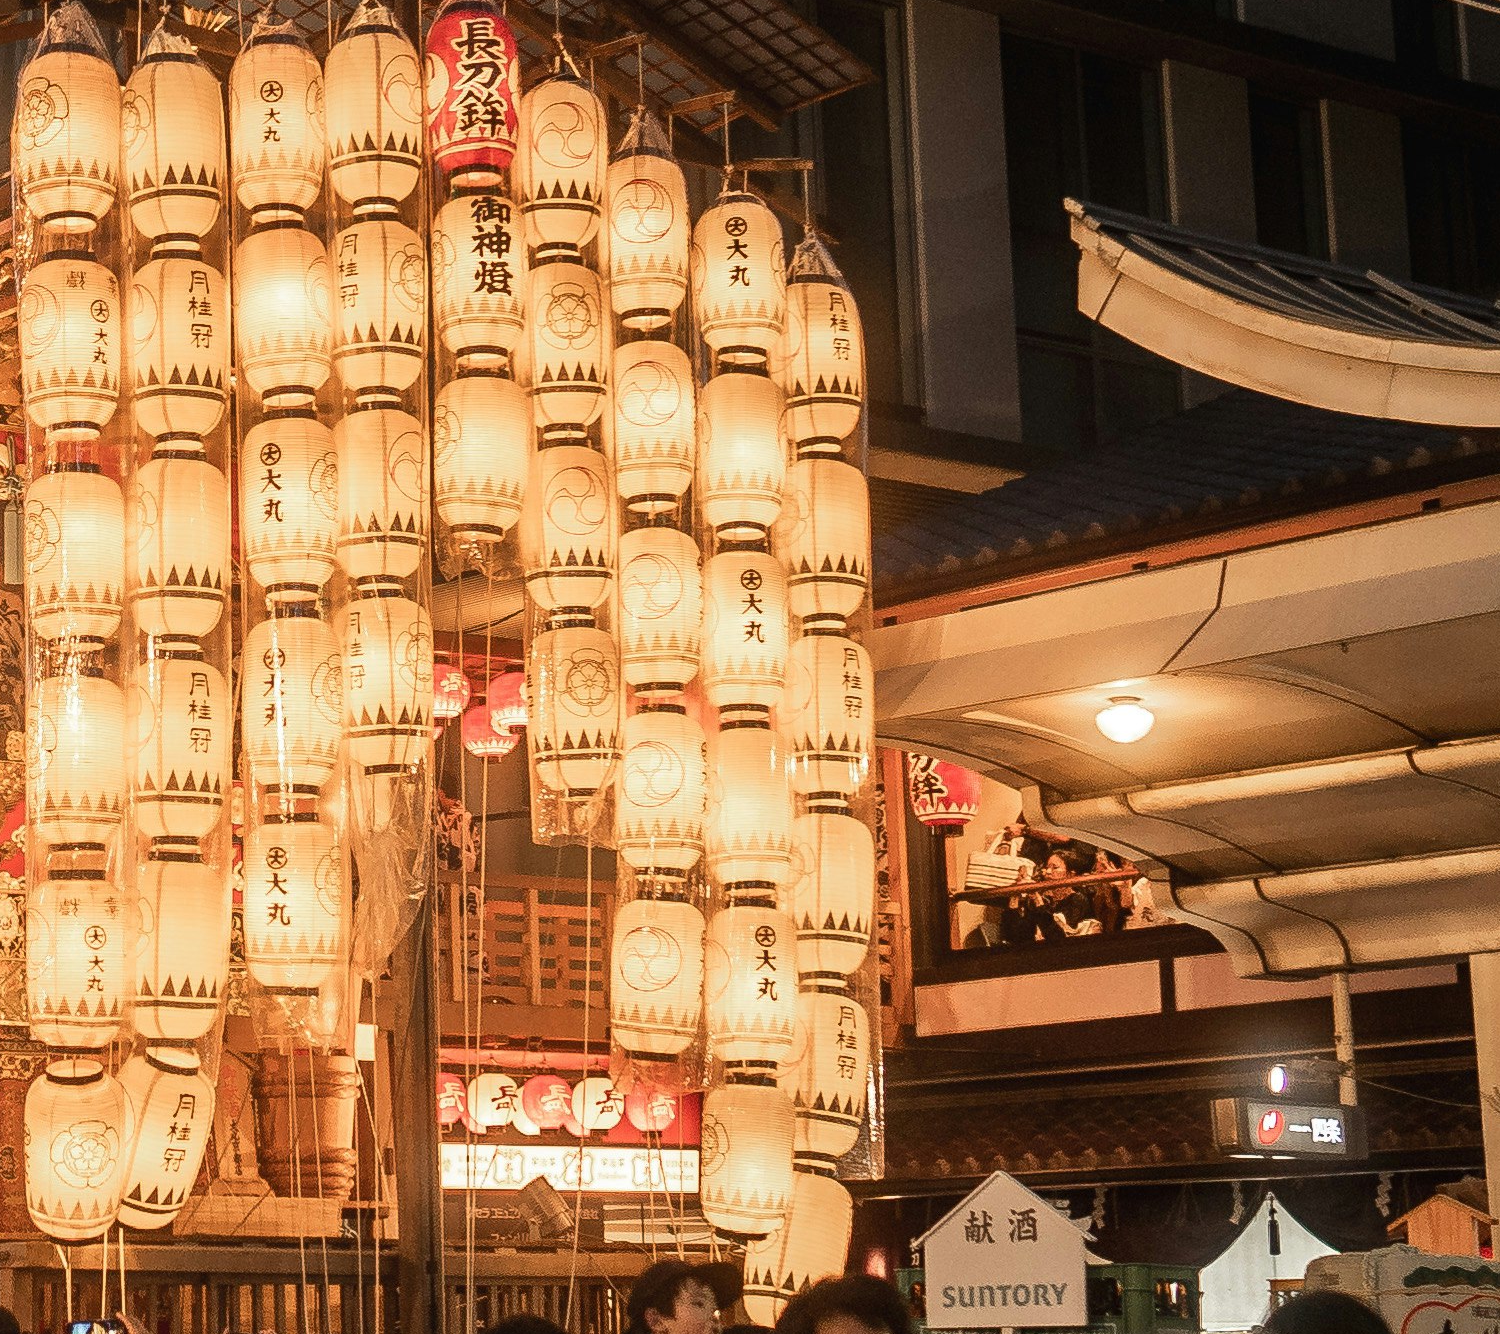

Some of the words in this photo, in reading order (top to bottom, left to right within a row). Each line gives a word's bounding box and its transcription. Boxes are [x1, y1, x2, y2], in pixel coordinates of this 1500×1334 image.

[455, 20, 506, 139] 長刀鉾
[261, 107, 281, 143] 大丸
[726, 239, 750, 287] 大丸
[92, 327, 109, 365] 大丸
[261, 469, 284, 524] 大丸
[742, 593, 765, 644] 大丸
[265, 872, 291, 926] 大丸
[87, 955, 105, 993] 大丸
[756, 949, 778, 1002] 大丸
[160, 1093, 196, 1172] 月桂冠
[963, 1207, 1039, 1244] 献酒
[941, 1282, 1068, 1309] SUNTORY
